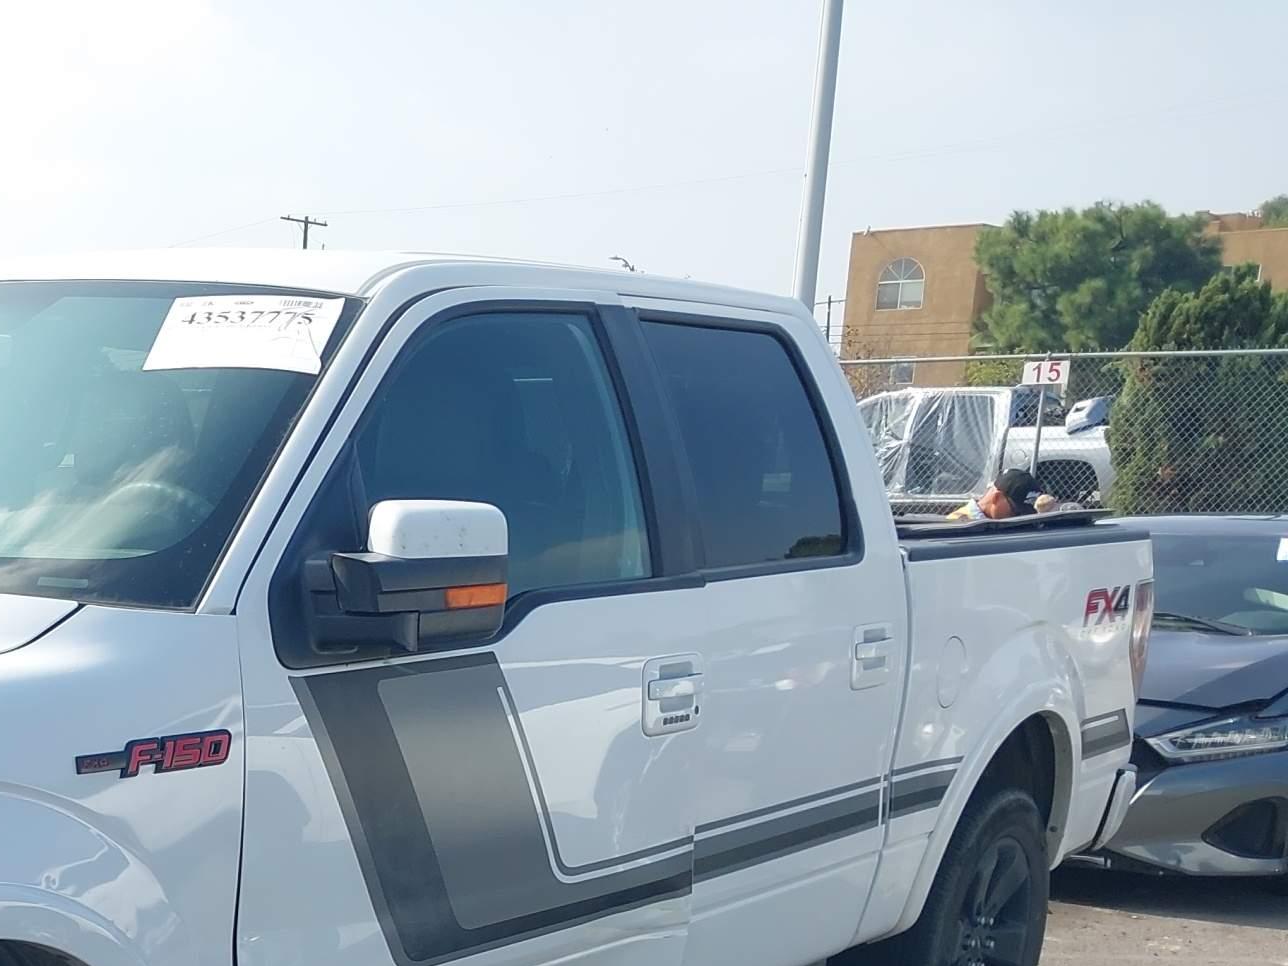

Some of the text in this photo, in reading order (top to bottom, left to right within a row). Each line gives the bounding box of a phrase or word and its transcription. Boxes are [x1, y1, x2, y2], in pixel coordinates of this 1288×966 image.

[181, 310, 316, 330] 43537775
[1032, 362, 1062, 382] 15
[1083, 584, 1131, 627] FX4
[126, 733, 230, 775] F-150
